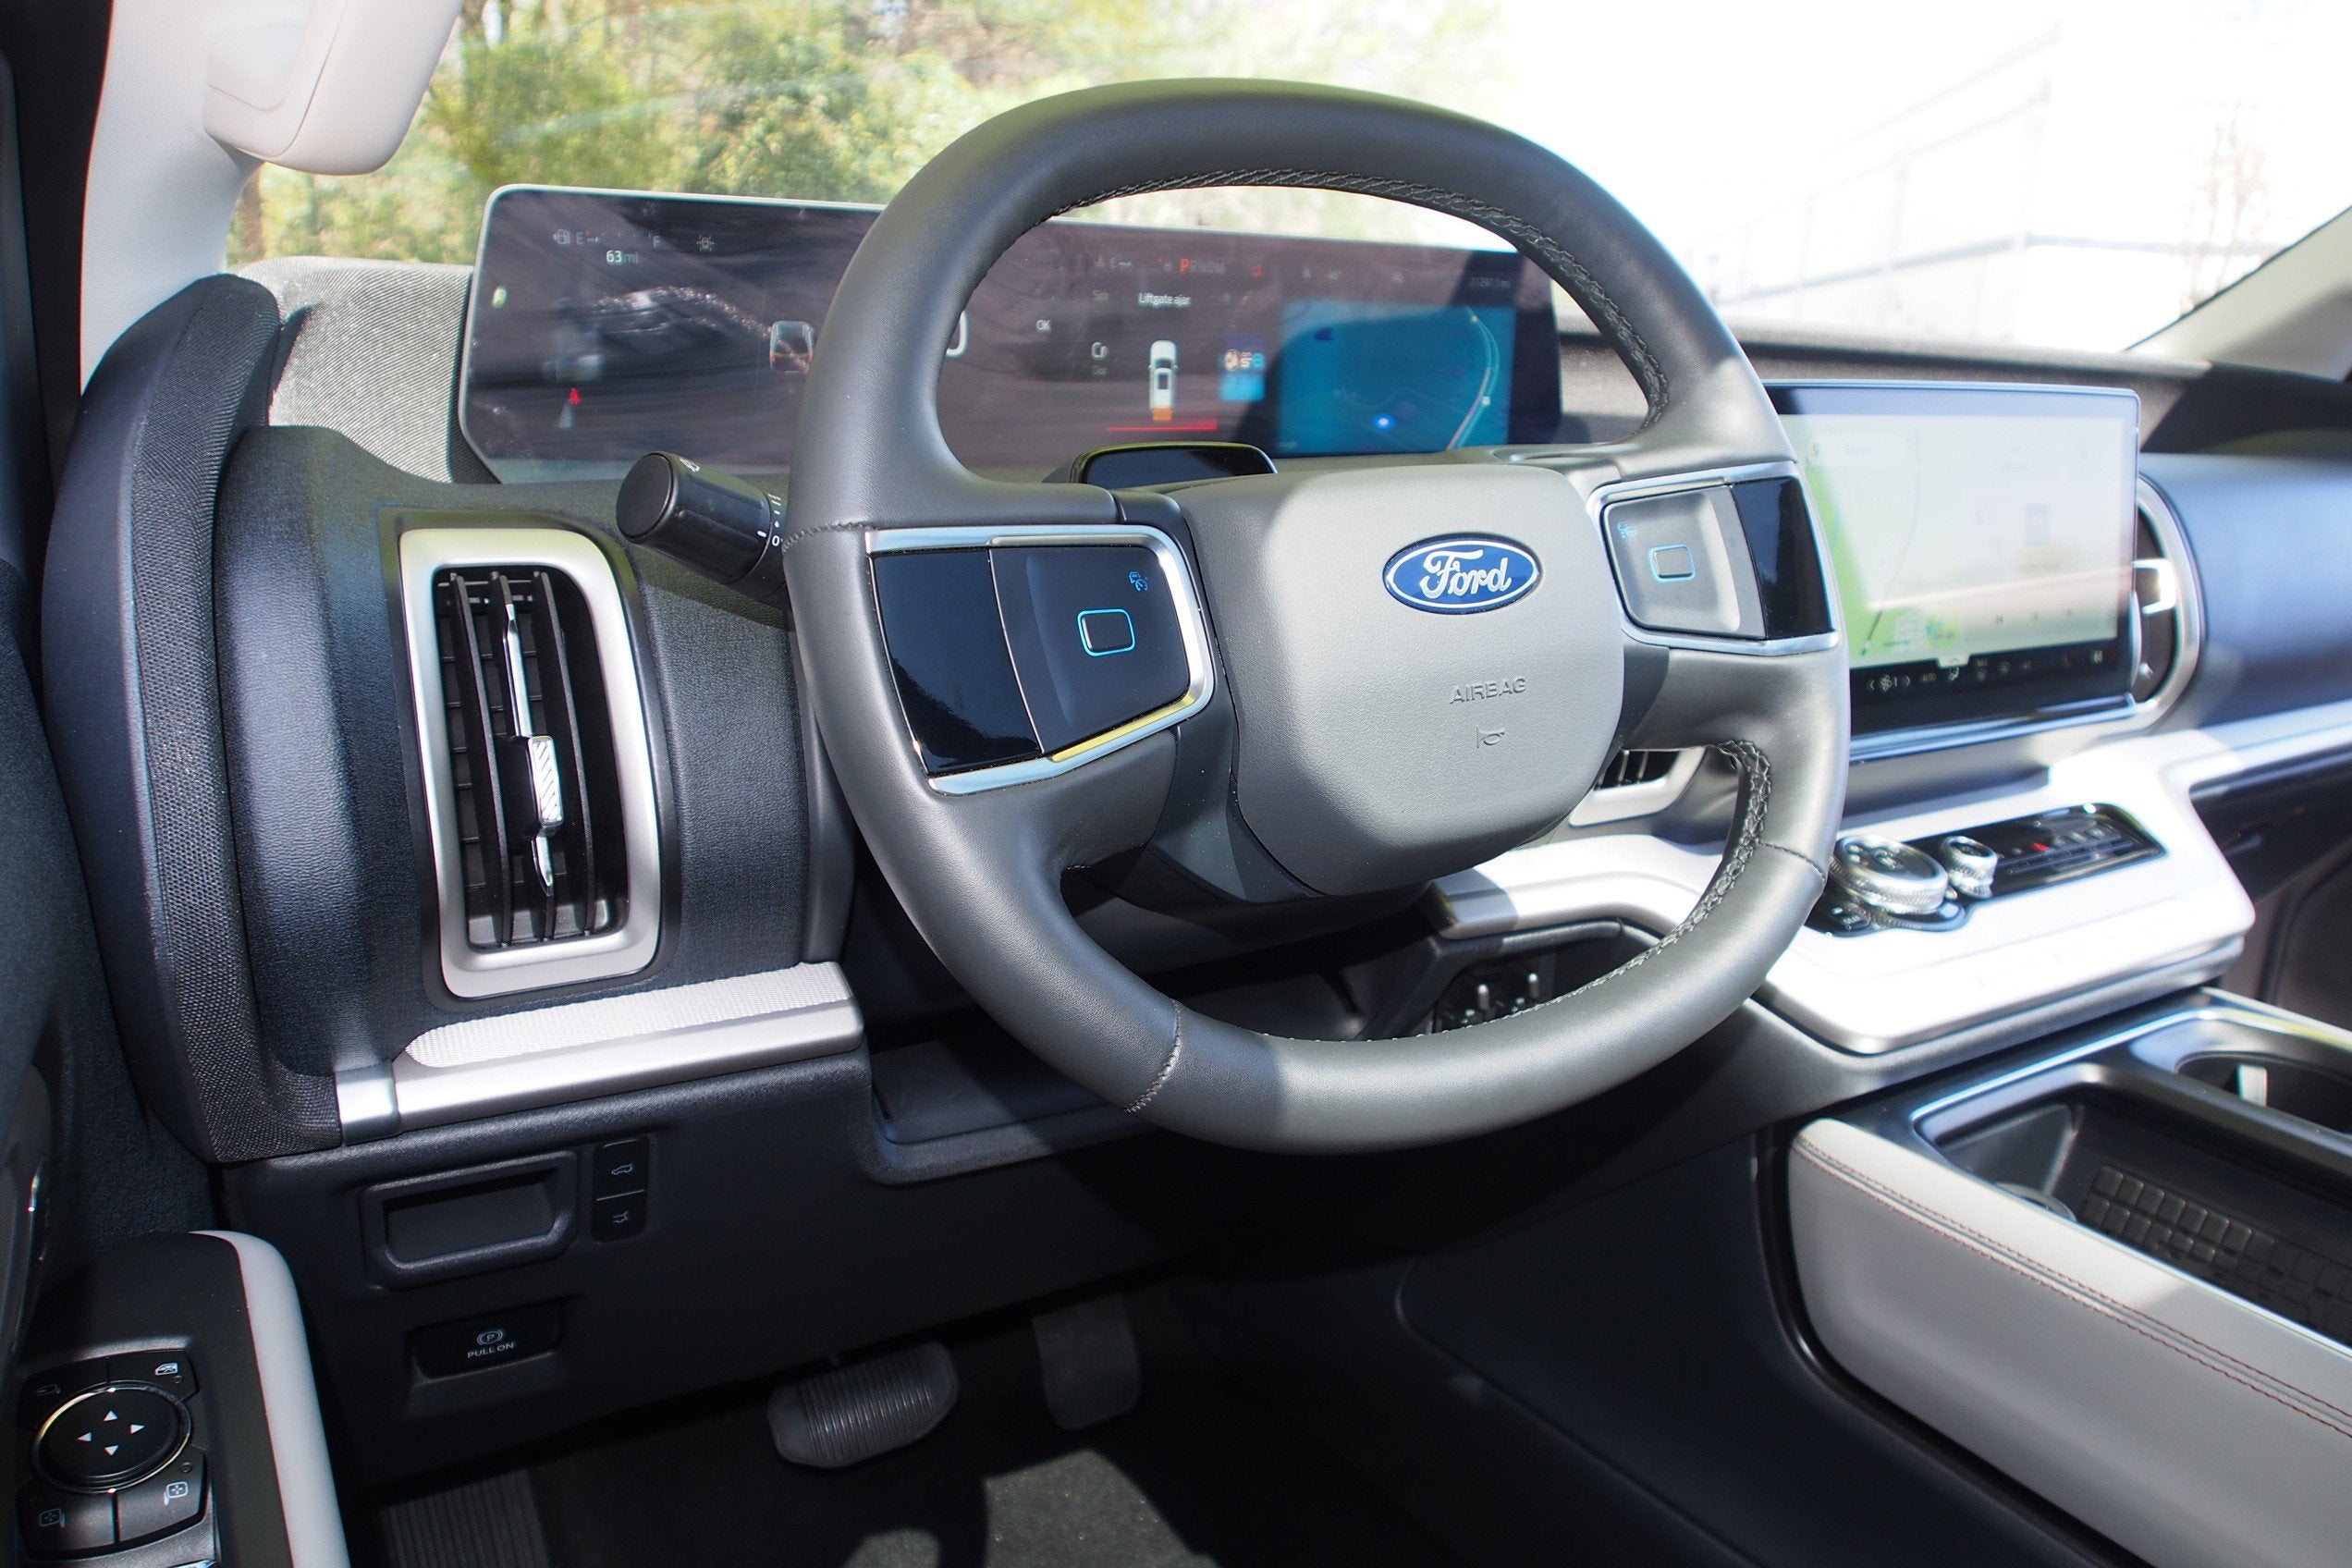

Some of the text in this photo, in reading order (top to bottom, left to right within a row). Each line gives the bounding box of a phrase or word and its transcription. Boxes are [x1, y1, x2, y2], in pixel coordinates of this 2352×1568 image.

[606, 250, 623, 263] 63
[1138, 292, 1191, 307] Liftgate ajar
[1035, 319, 1052, 331] OK
[1419, 549, 1513, 599] Ford
[1449, 677, 1527, 705] AIRBAG
[467, 1341, 515, 1358] PULL ON
